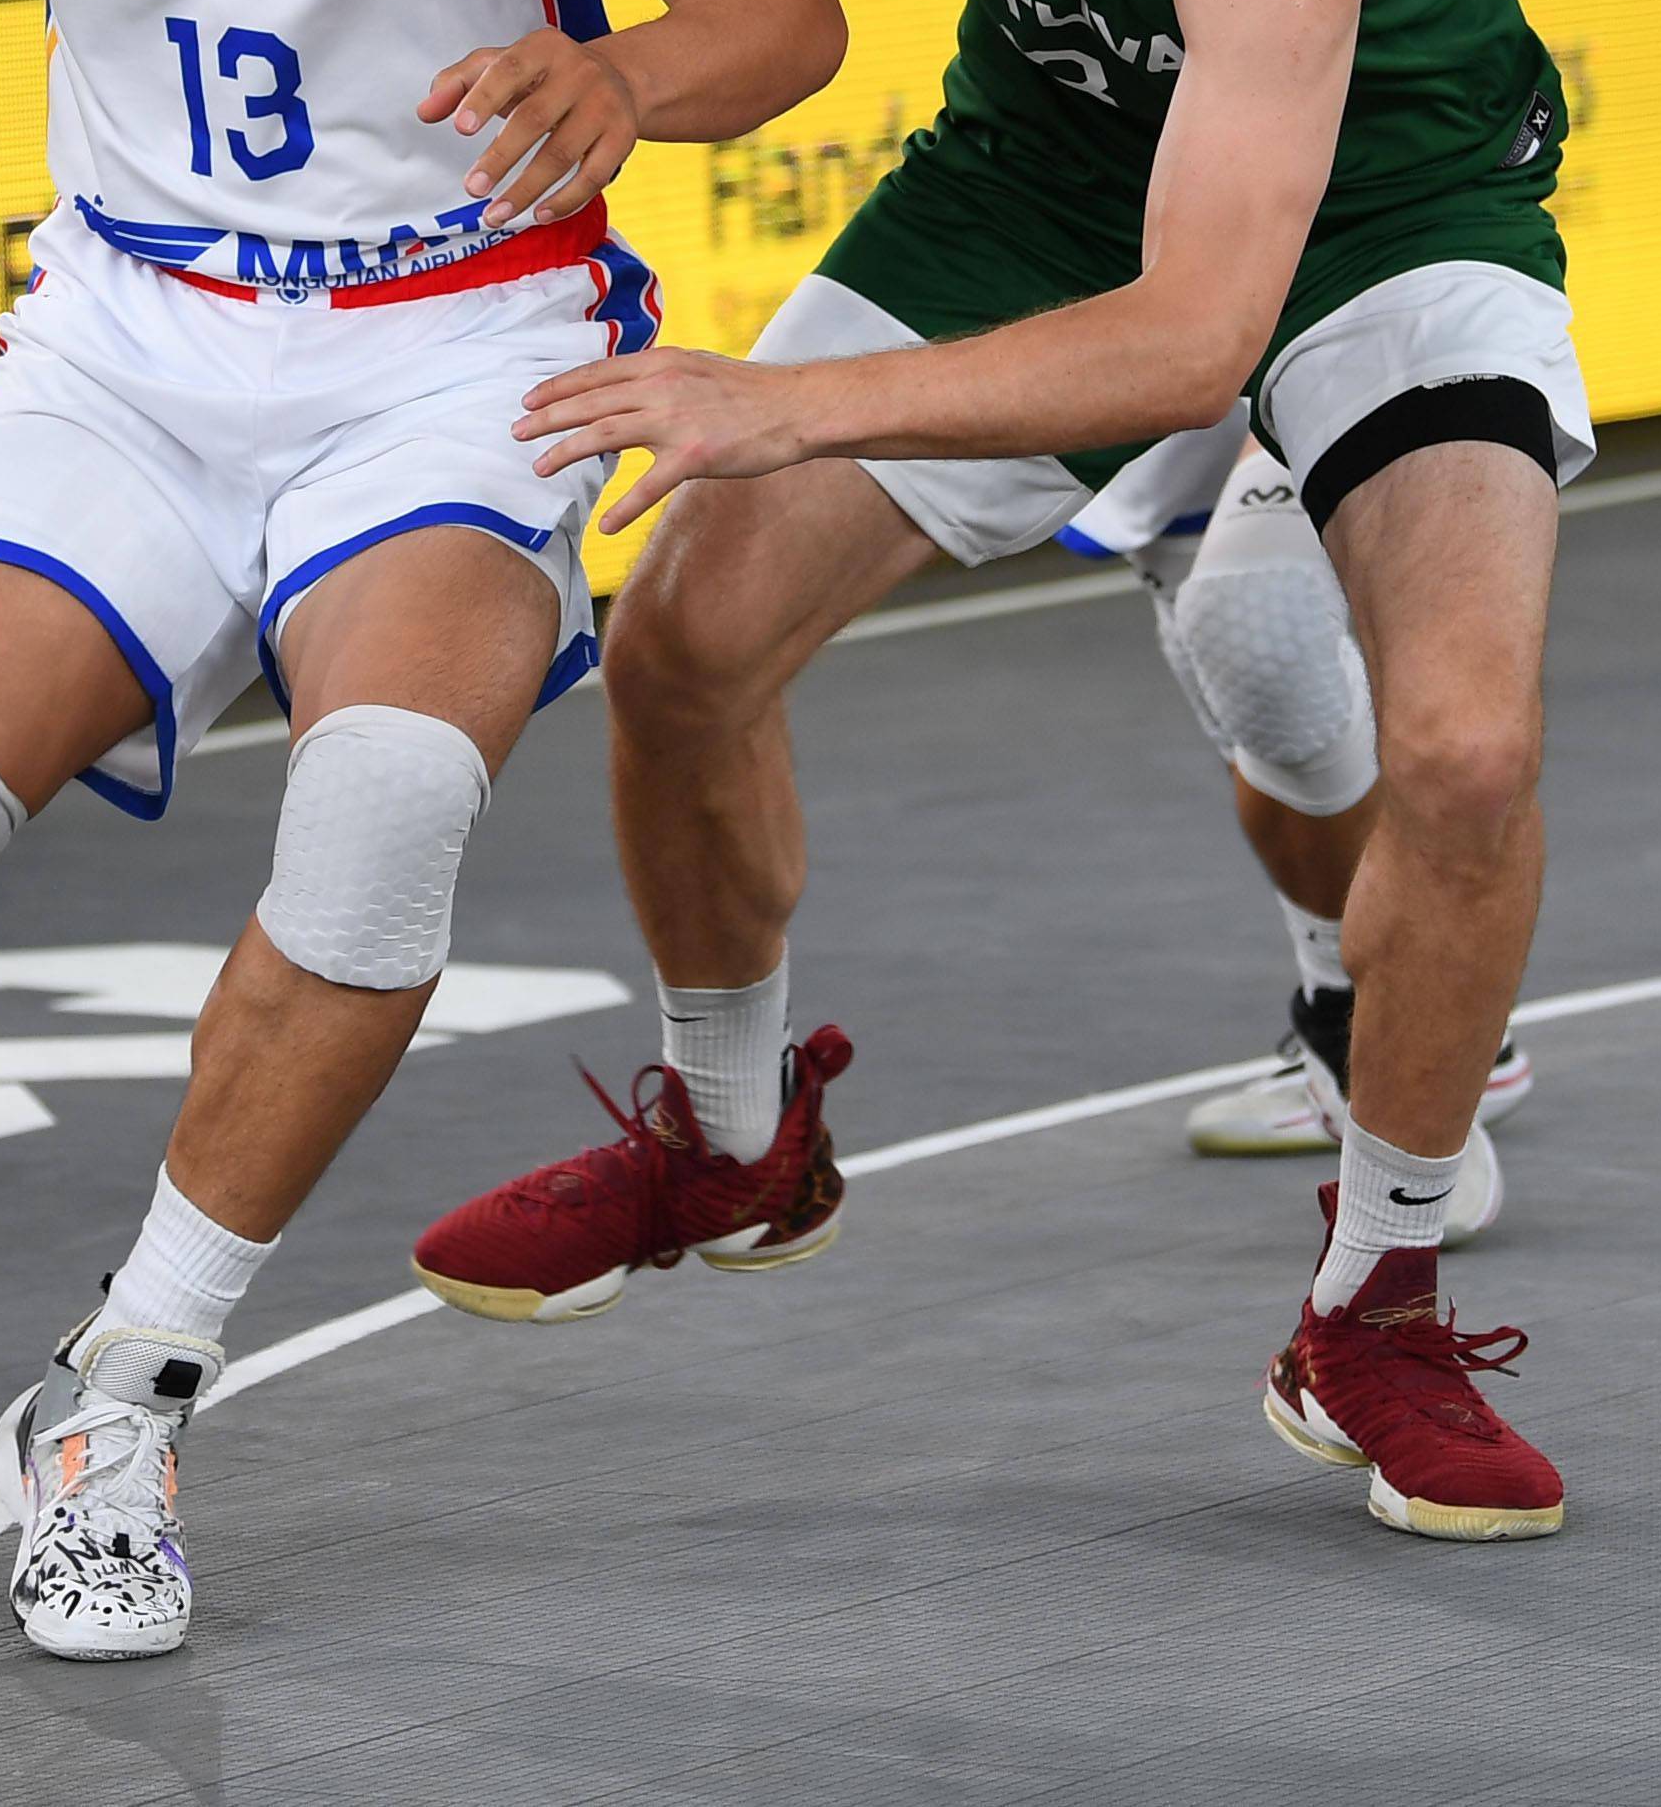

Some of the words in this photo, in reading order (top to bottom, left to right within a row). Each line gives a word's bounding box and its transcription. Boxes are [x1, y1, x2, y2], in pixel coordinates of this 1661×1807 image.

[165, 17, 316, 182] 13
[1531, 107, 1551, 132] XL
[239, 261, 399, 290] MONGOLIAN
[410, 226, 517, 277] AIRLINES
